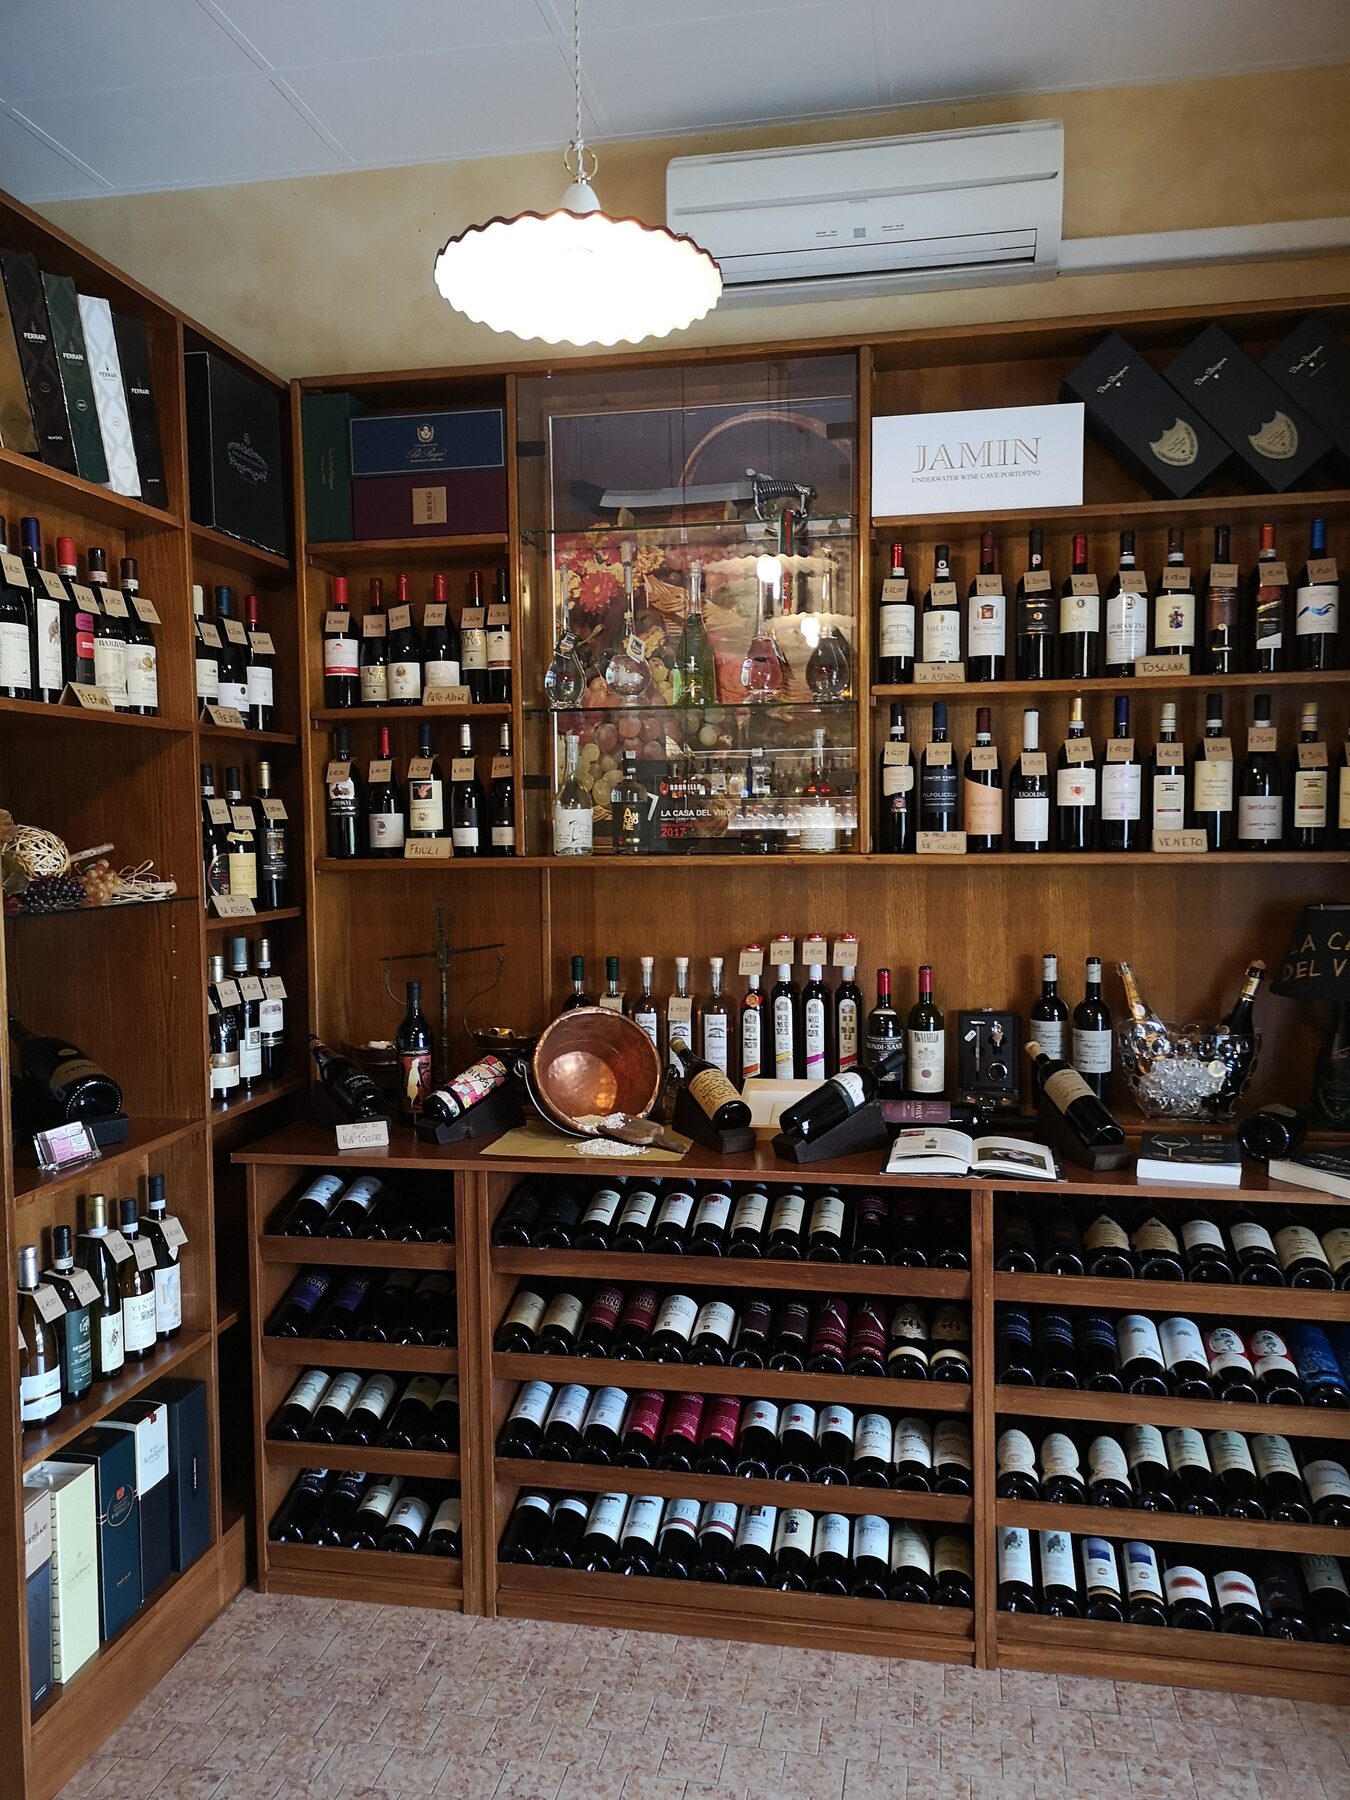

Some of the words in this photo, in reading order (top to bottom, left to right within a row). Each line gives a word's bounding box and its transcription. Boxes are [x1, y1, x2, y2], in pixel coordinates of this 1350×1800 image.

[23, 332, 47, 341] FERRARI
[62, 352, 84, 361] FERRARI
[912, 437, 1042, 473] JAMIN
[912, 475, 959, 484] UNDERWATER
[961, 473, 979, 481] WINE
[980, 472, 999, 480] CAVE
[1000, 470, 1041, 479] PORTOFINO
[1142, 661, 1186, 673] TOSCANA
[661, 809, 671, 817] LA
[672, 809, 695, 817] CASA
[660, 827, 686, 838] 2017
[1158, 837, 1203, 848] VENETO
[1282, 959, 1322, 982] DEL
